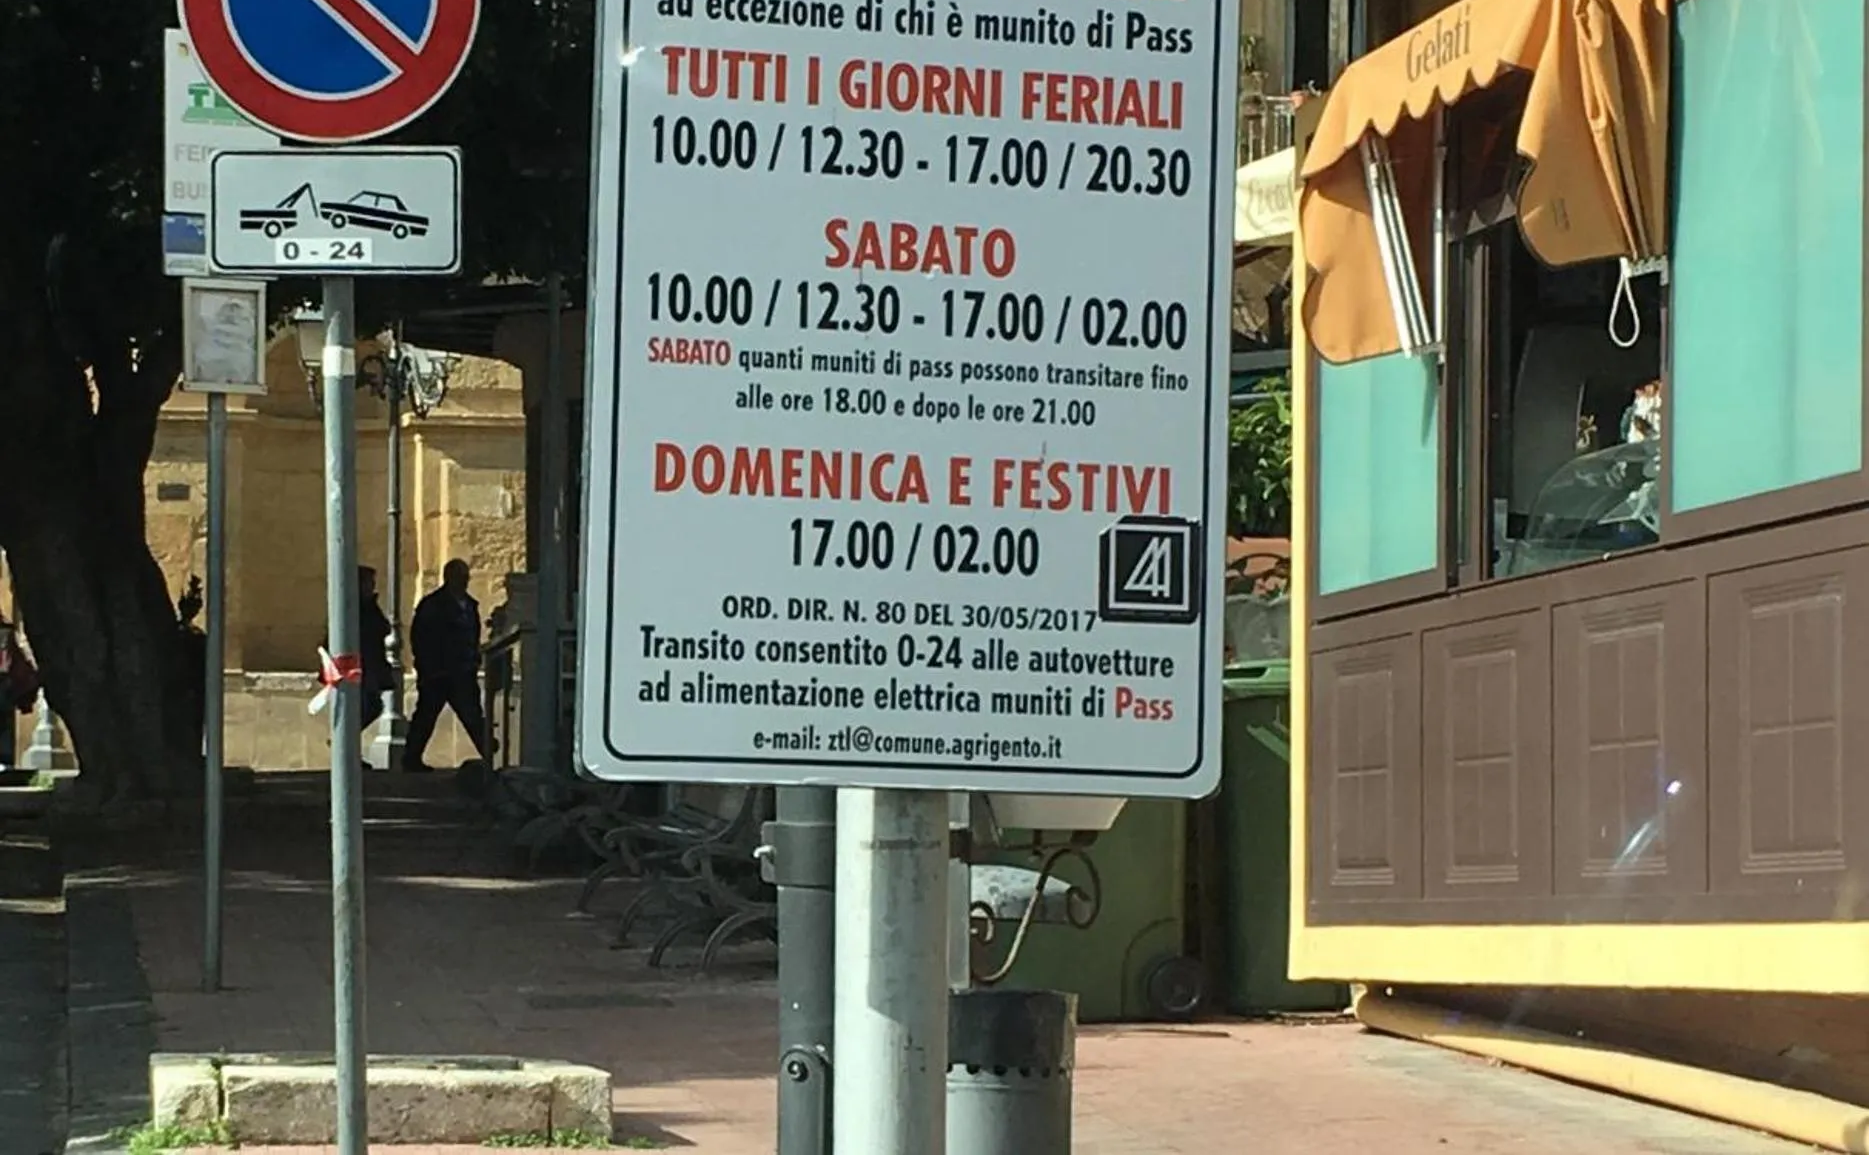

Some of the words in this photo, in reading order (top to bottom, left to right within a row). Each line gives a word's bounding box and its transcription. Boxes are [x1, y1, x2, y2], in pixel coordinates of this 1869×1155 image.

[946, 1, 964, 39] è
[974, 7, 1076, 47] munito
[1086, 8, 1115, 50] di
[1125, 10, 1193, 55] Pass
[1405, 3, 1471, 83] Gelati
[661, 46, 788, 103] TUTTI
[807, 56, 821, 106] I
[839, 59, 1003, 119] GIORNI
[1021, 71, 1184, 130] FERIALI
[652, 114, 758, 170] 10.00
[767, 122, 786, 172] /
[800, 125, 905, 180] 12.30
[946, 134, 1048, 189] 17.00
[1058, 141, 1076, 191] /
[1085, 143, 1192, 198] 20.30
[283, 241, 300, 261] 0
[329, 241, 365, 261] 24
[824, 218, 1016, 278] SABATO
[648, 271, 753, 326] 10.00
[763, 278, 782, 328] /
[797, 280, 901, 335] 12.30
[942, 289, 1045, 343] 17.00
[1054, 295, 1072, 345] /
[1082, 297, 1188, 351] 02.00
[648, 336, 731, 366] SABATO
[738, 345, 804, 373] quanti
[811, 349, 876, 375] muniti
[882, 349, 902, 376] di
[909, 359, 954, 382] pass
[960, 362, 1040, 385] possono
[1046, 362, 1144, 389] transitare
[1150, 363, 1189, 391] fino
[735, 382, 774, 410] alle
[780, 393, 814, 412] ore
[823, 387, 887, 416] 18.00
[893, 398, 906, 417] e
[912, 391, 961, 424] dopo
[967, 393, 986, 421] le
[992, 404, 1025, 423] ore
[1031, 397, 1096, 427] 21.00
[654, 442, 930, 504] DOMENICA
[949, 456, 973, 506] E
[993, 457, 1171, 516] FESTIVI
[790, 517, 895, 571] 17.00
[905, 522, 923, 572] /
[932, 523, 1040, 577] 02.00
[721, 595, 779, 620] ORD.
[787, 597, 835, 622] DIR.
[843, 599, 867, 623] N.
[875, 600, 907, 625] 80
[914, 602, 955, 627] DEL
[961, 604, 1098, 633] 30/05/2017
[639, 624, 745, 662] Transito
[755, 634, 888, 667] consentito
[897, 633, 964, 670] 0-24
[971, 637, 1020, 672] alle
[1028, 646, 1175, 679] autovetture
[638, 669, 671, 703] ad
[680, 670, 865, 709] alimentazione
[873, 677, 981, 713] elettrica
[991, 685, 1073, 717] muniti
[1081, 684, 1106, 718] di
[1115, 686, 1174, 721] Pass
[753, 724, 821, 751] e-mail:
[827, 725, 1062, 762] ztl@comune.agrigento.it
